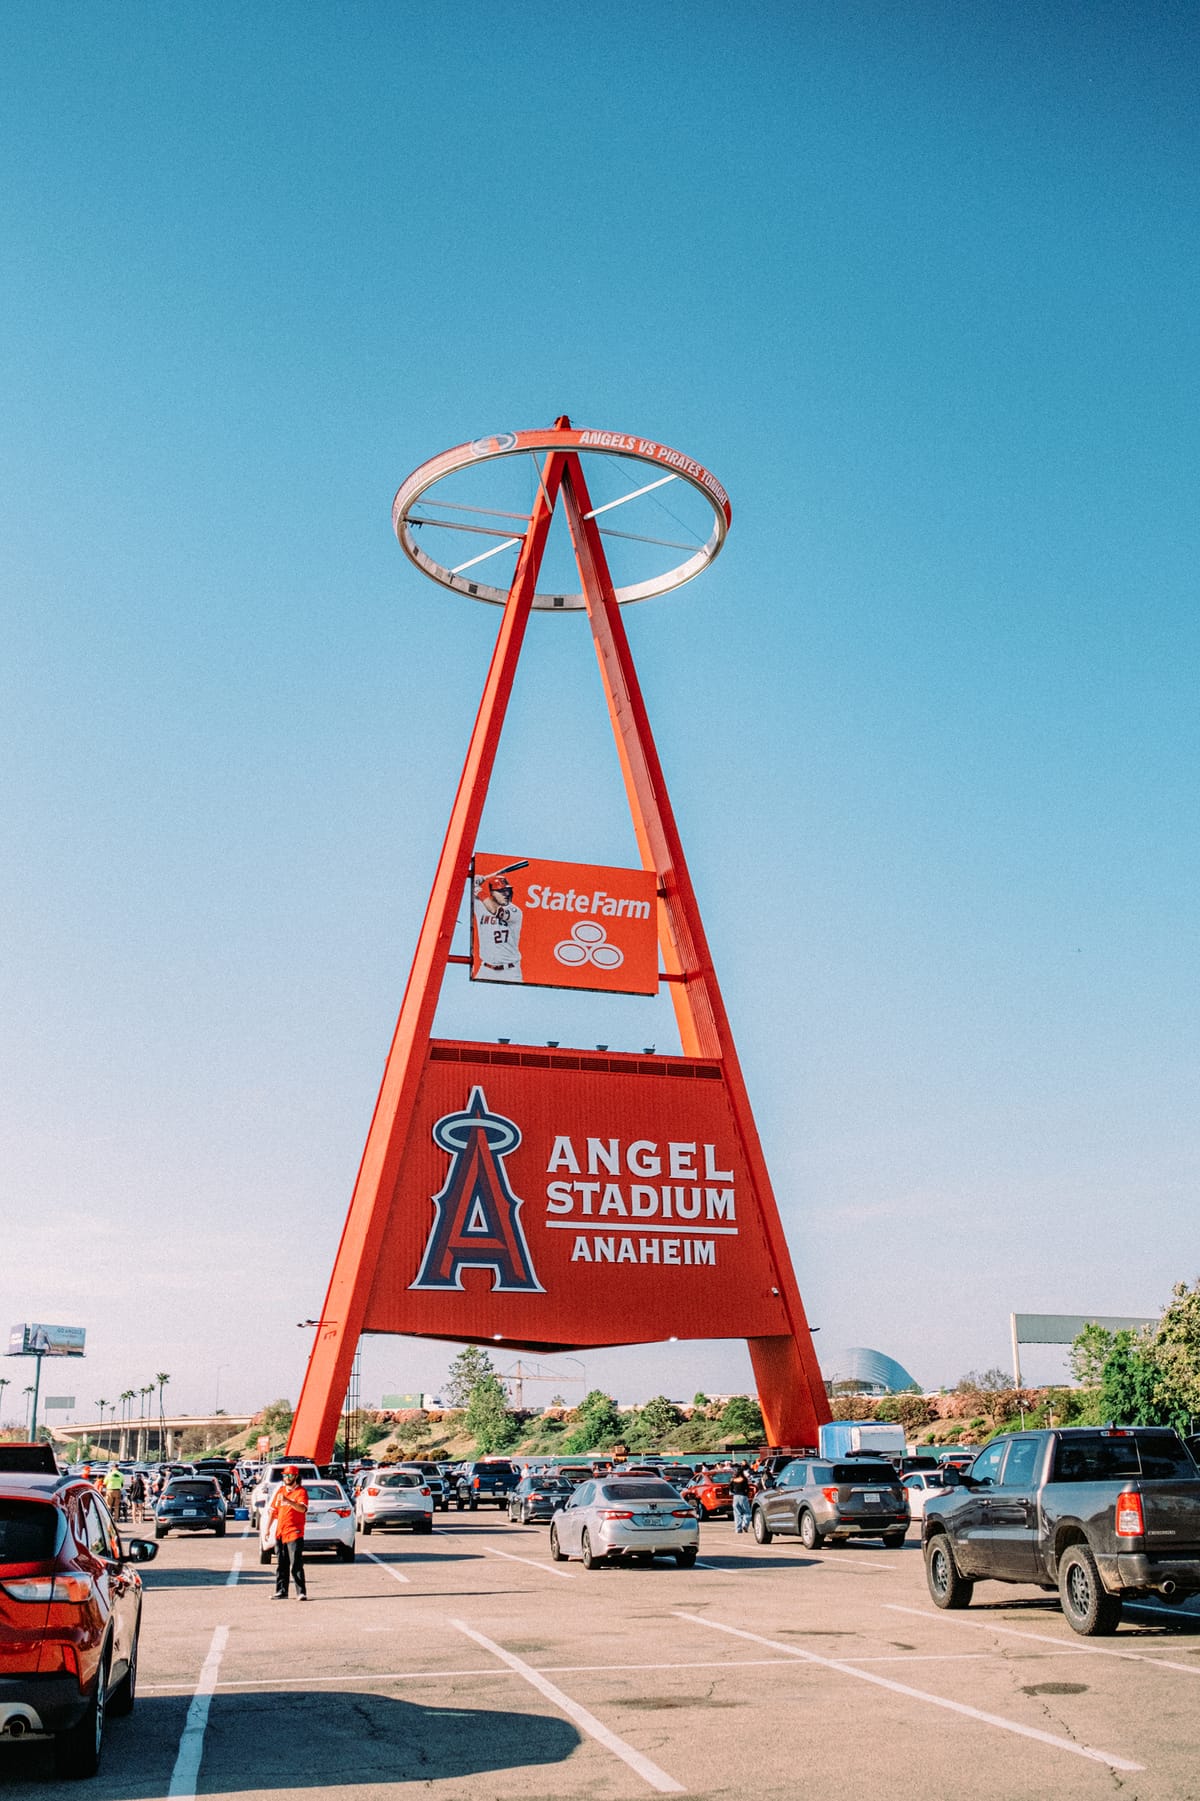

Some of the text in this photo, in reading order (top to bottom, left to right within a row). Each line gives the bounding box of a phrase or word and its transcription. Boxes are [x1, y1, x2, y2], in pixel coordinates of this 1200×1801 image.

[579, 431, 729, 506] ANGELS VS PIRATES TONIGHT
[494, 930, 509, 944] 27
[546, 1136, 734, 1182] ANGEL
[407, 1085, 548, 1292] A
[546, 1180, 737, 1220] STADIUM
[571, 1236, 717, 1266] ANAHEIM
